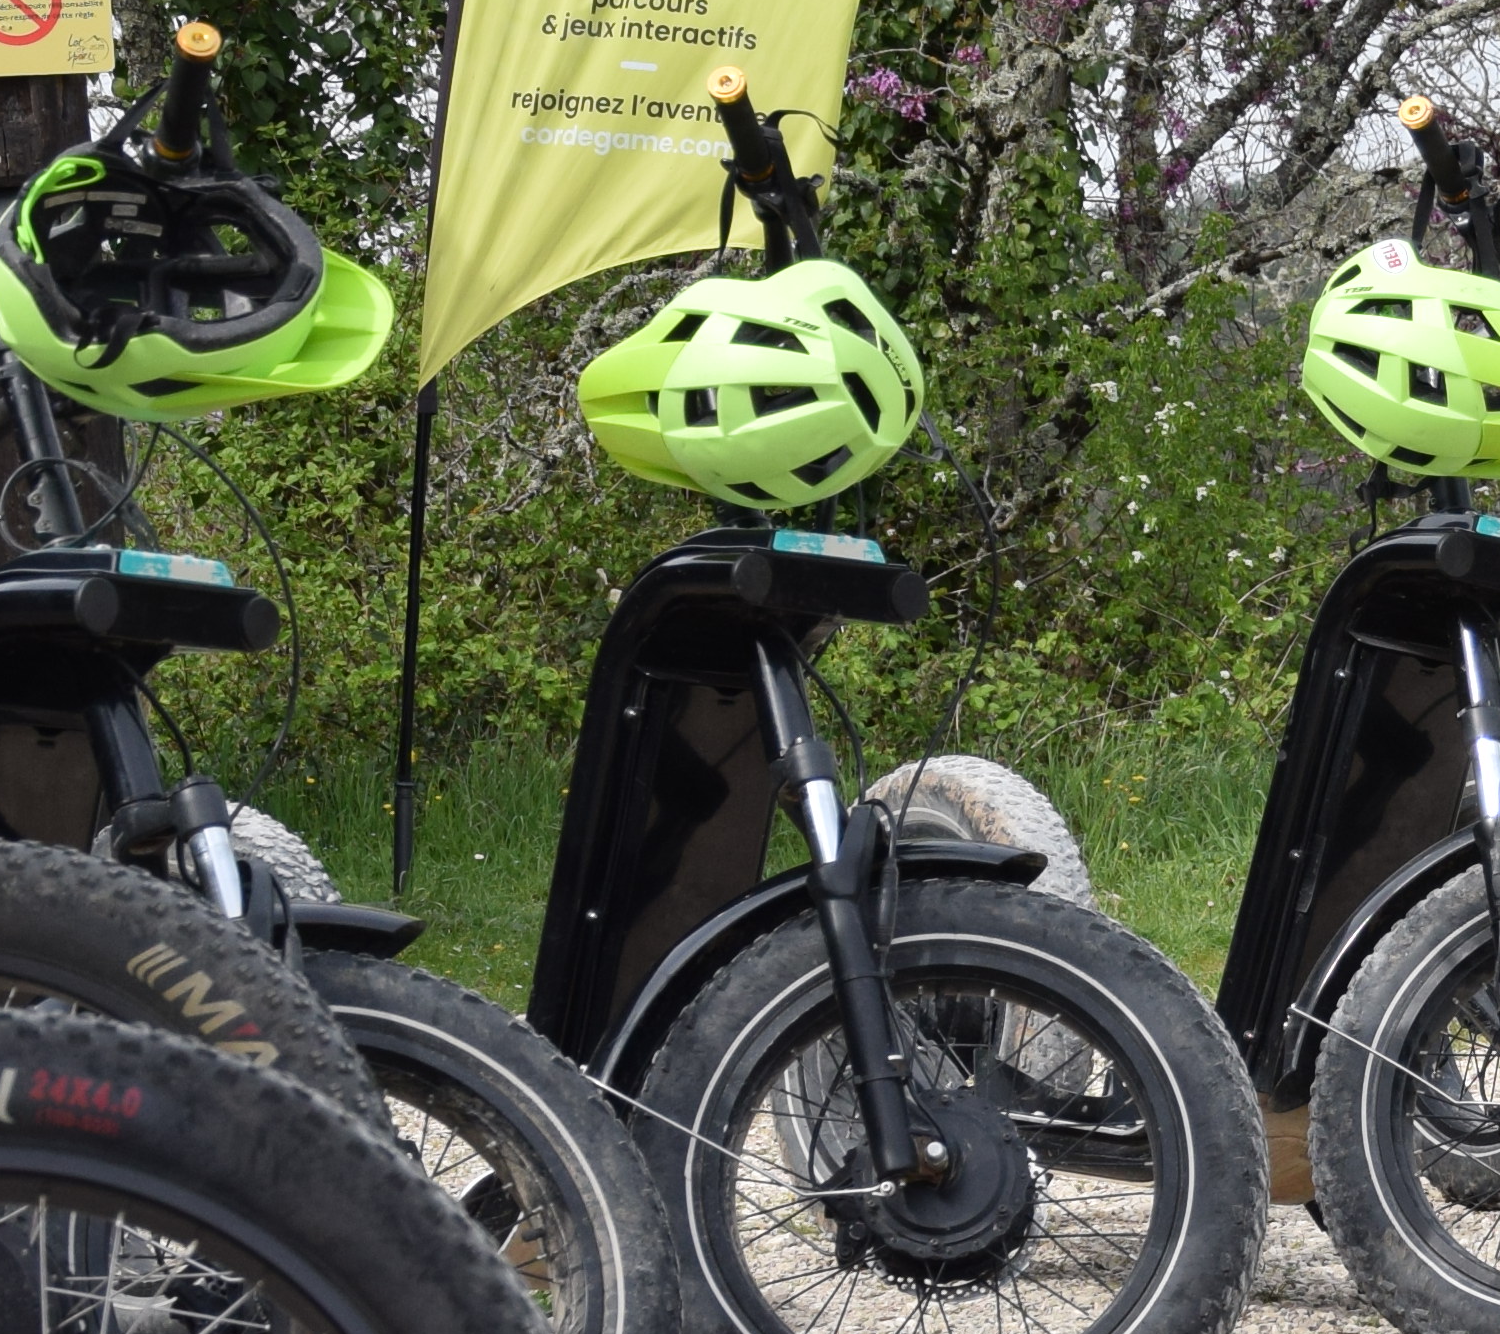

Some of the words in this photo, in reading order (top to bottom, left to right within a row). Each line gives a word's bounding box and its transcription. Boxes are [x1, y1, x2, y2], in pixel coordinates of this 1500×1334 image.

[541, 14, 558, 35] &
[560, 12, 615, 42] jeux
[619, 16, 758, 51] interactifs
[511, 87, 625, 119] rejoignez
[631, 94, 768, 126] l'avene
[1380, 242, 1403, 269] BELL
